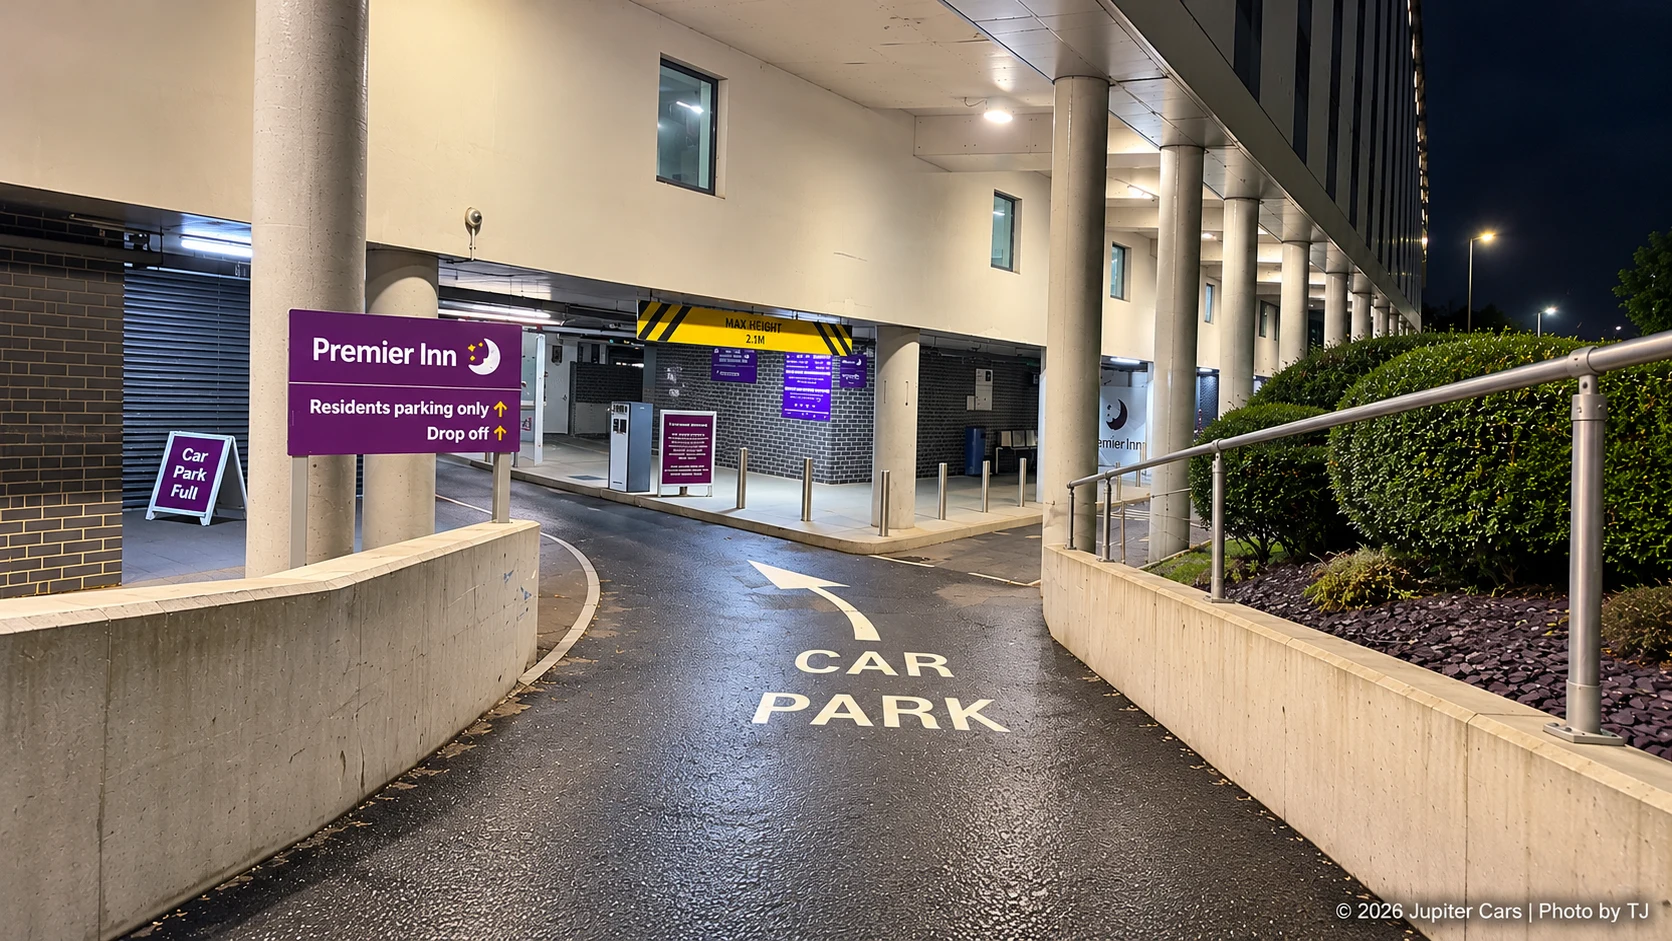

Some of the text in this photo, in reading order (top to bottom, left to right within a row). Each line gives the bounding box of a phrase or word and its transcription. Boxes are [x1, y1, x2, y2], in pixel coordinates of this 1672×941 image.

[725, 317, 782, 334] MAX HEIGHT
[746, 334, 765, 345] 2.1M
[312, 336, 457, 367] Premier Inn
[309, 399, 490, 419] Residents parking only
[427, 426, 490, 443] Drop off
[182, 447, 209, 463] Car
[172, 465, 207, 482] Park
[170, 483, 199, 500] Full
[794, 649, 955, 678] CAR
[751, 691, 1012, 733] PARK
